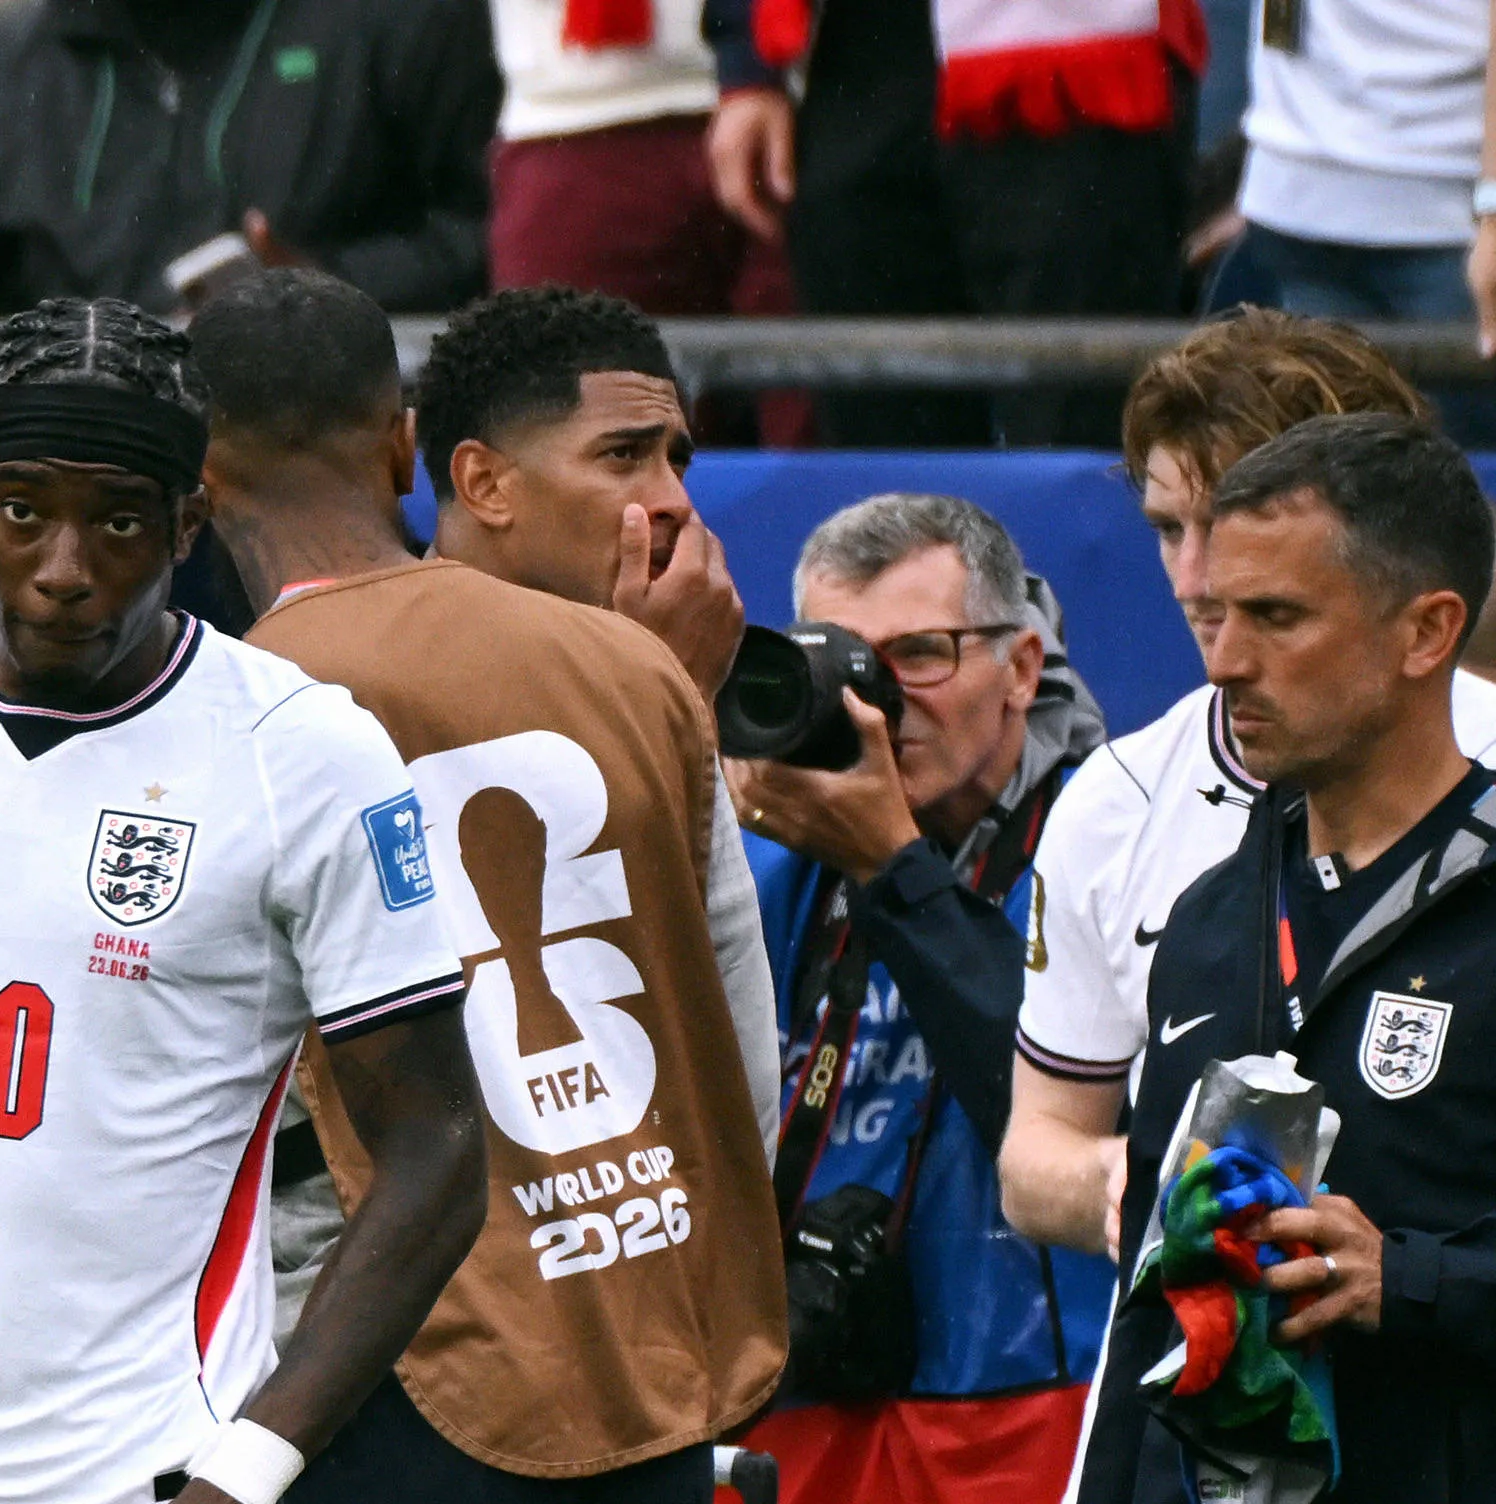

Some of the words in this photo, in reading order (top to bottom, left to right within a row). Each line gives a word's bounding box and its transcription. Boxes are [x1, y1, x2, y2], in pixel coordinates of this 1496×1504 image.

[93, 931, 151, 960] GHANA
[526, 1061, 611, 1118] FIFA
[512, 1161, 624, 1217] WORLD
[627, 1146, 675, 1186] CUP
[529, 1187, 692, 1281] 2026
